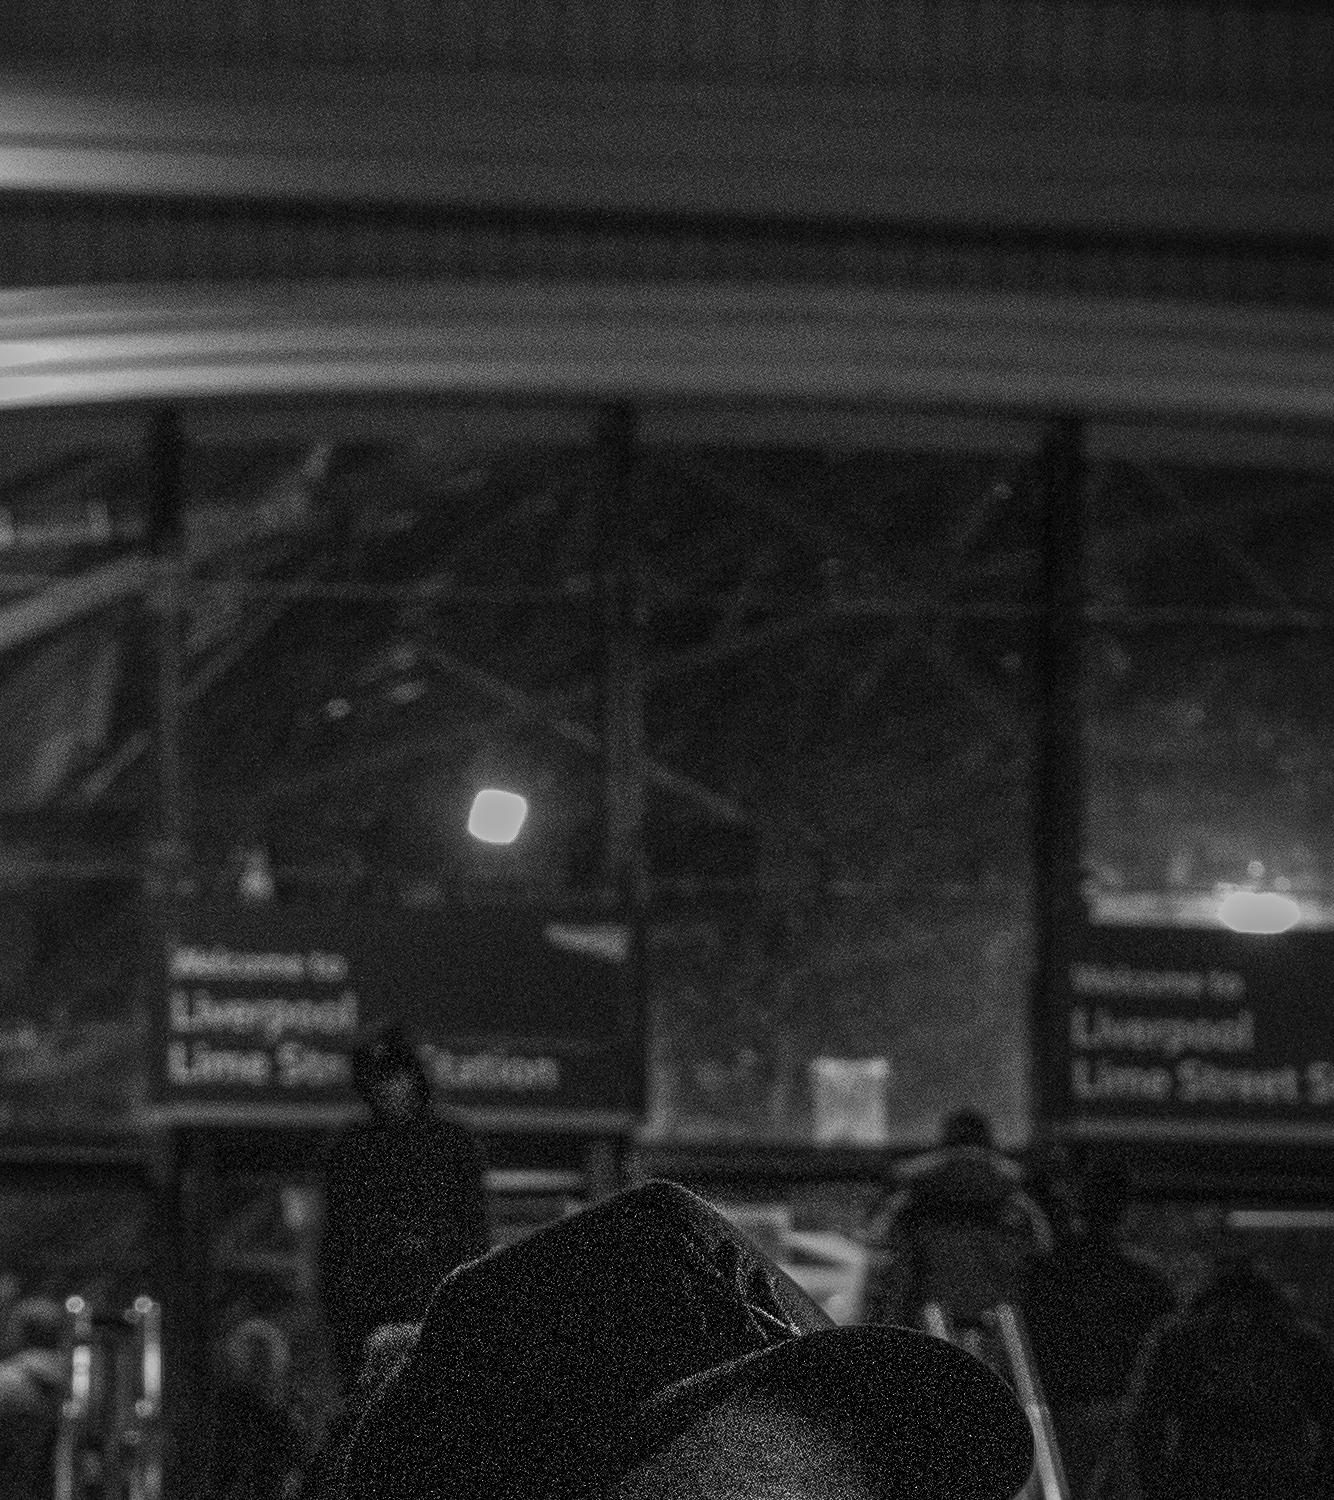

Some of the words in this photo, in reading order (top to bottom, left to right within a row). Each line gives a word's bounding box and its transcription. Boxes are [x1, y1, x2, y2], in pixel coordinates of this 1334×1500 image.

[169, 947, 303, 981] Welcome
[309, 950, 348, 982] to
[1070, 963, 1203, 997] Welcome
[1208, 968, 1246, 1000] to
[169, 990, 359, 1041] Liverpool
[1070, 1007, 1255, 1056] Liverpool
[169, 1041, 268, 1085] Lime
[1071, 1057, 1170, 1101] Lime
[1176, 1058, 1299, 1103] Street
